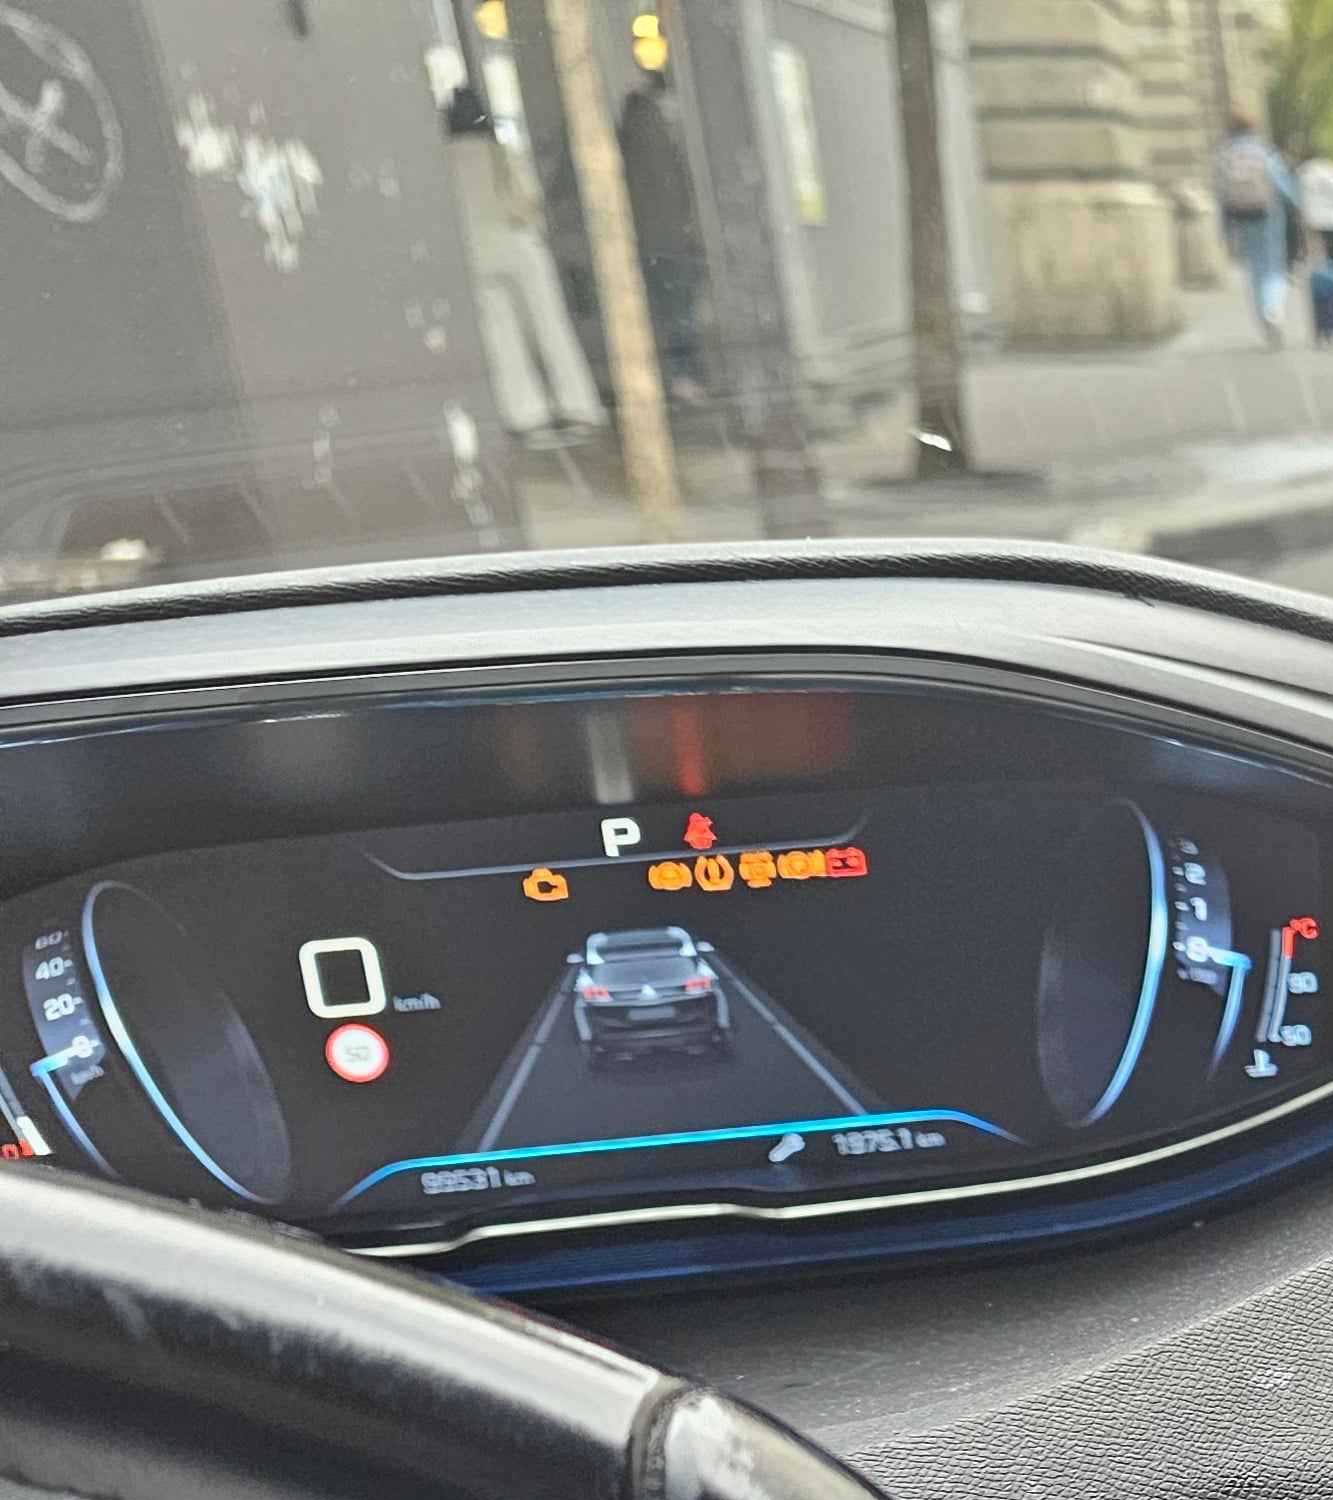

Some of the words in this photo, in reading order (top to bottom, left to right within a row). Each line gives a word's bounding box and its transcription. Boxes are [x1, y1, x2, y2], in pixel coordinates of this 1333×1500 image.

[601, 816, 641, 857] P
[1189, 897, 1208, 921] 1
[35, 956, 65, 980] 40
[299, 936, 387, 1018] 0
[43, 993, 75, 1021] 20
[72, 1035, 93, 1059] 0
